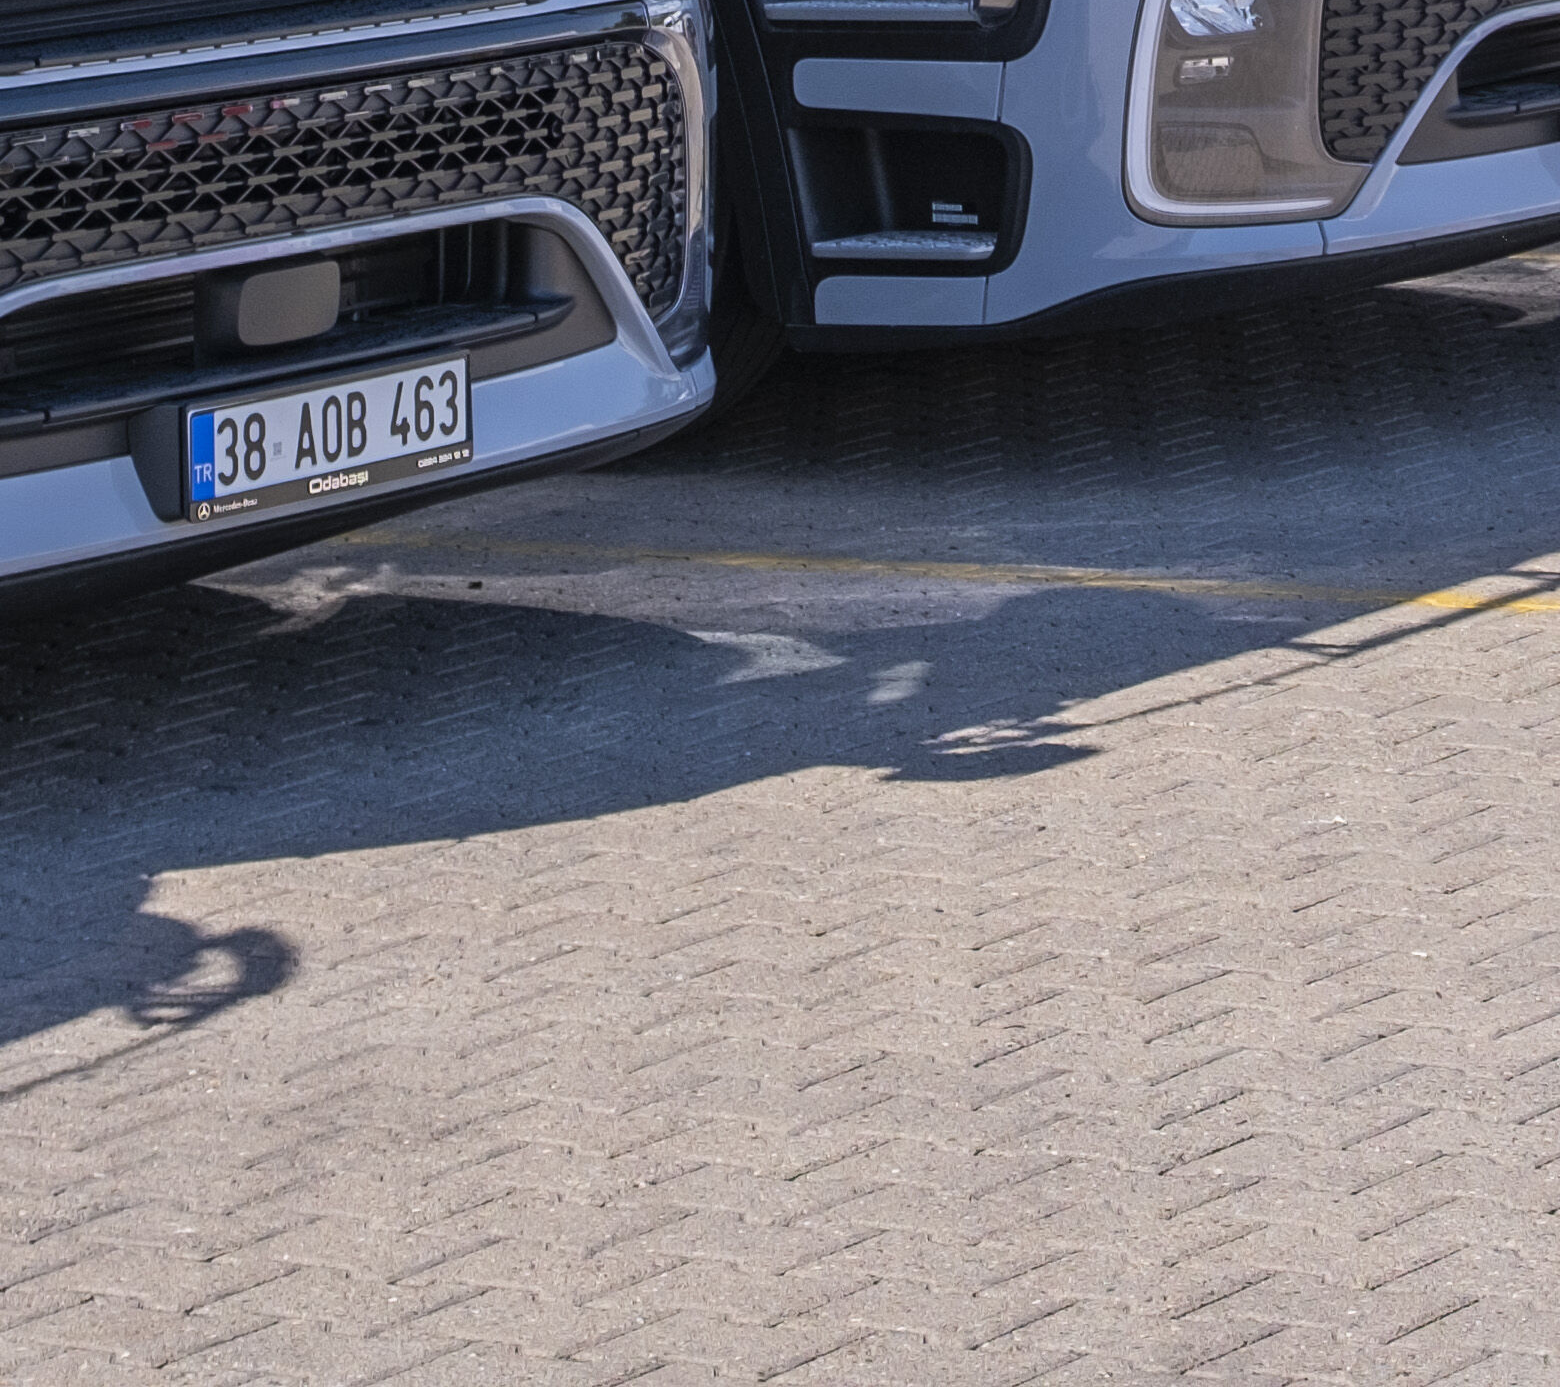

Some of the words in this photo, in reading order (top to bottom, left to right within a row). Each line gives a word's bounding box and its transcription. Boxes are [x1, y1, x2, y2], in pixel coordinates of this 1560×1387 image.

[194, 463, 213, 484] TR
[217, 412, 267, 486] 38
[295, 391, 368, 469] AOB
[390, 369, 459, 446] 463
